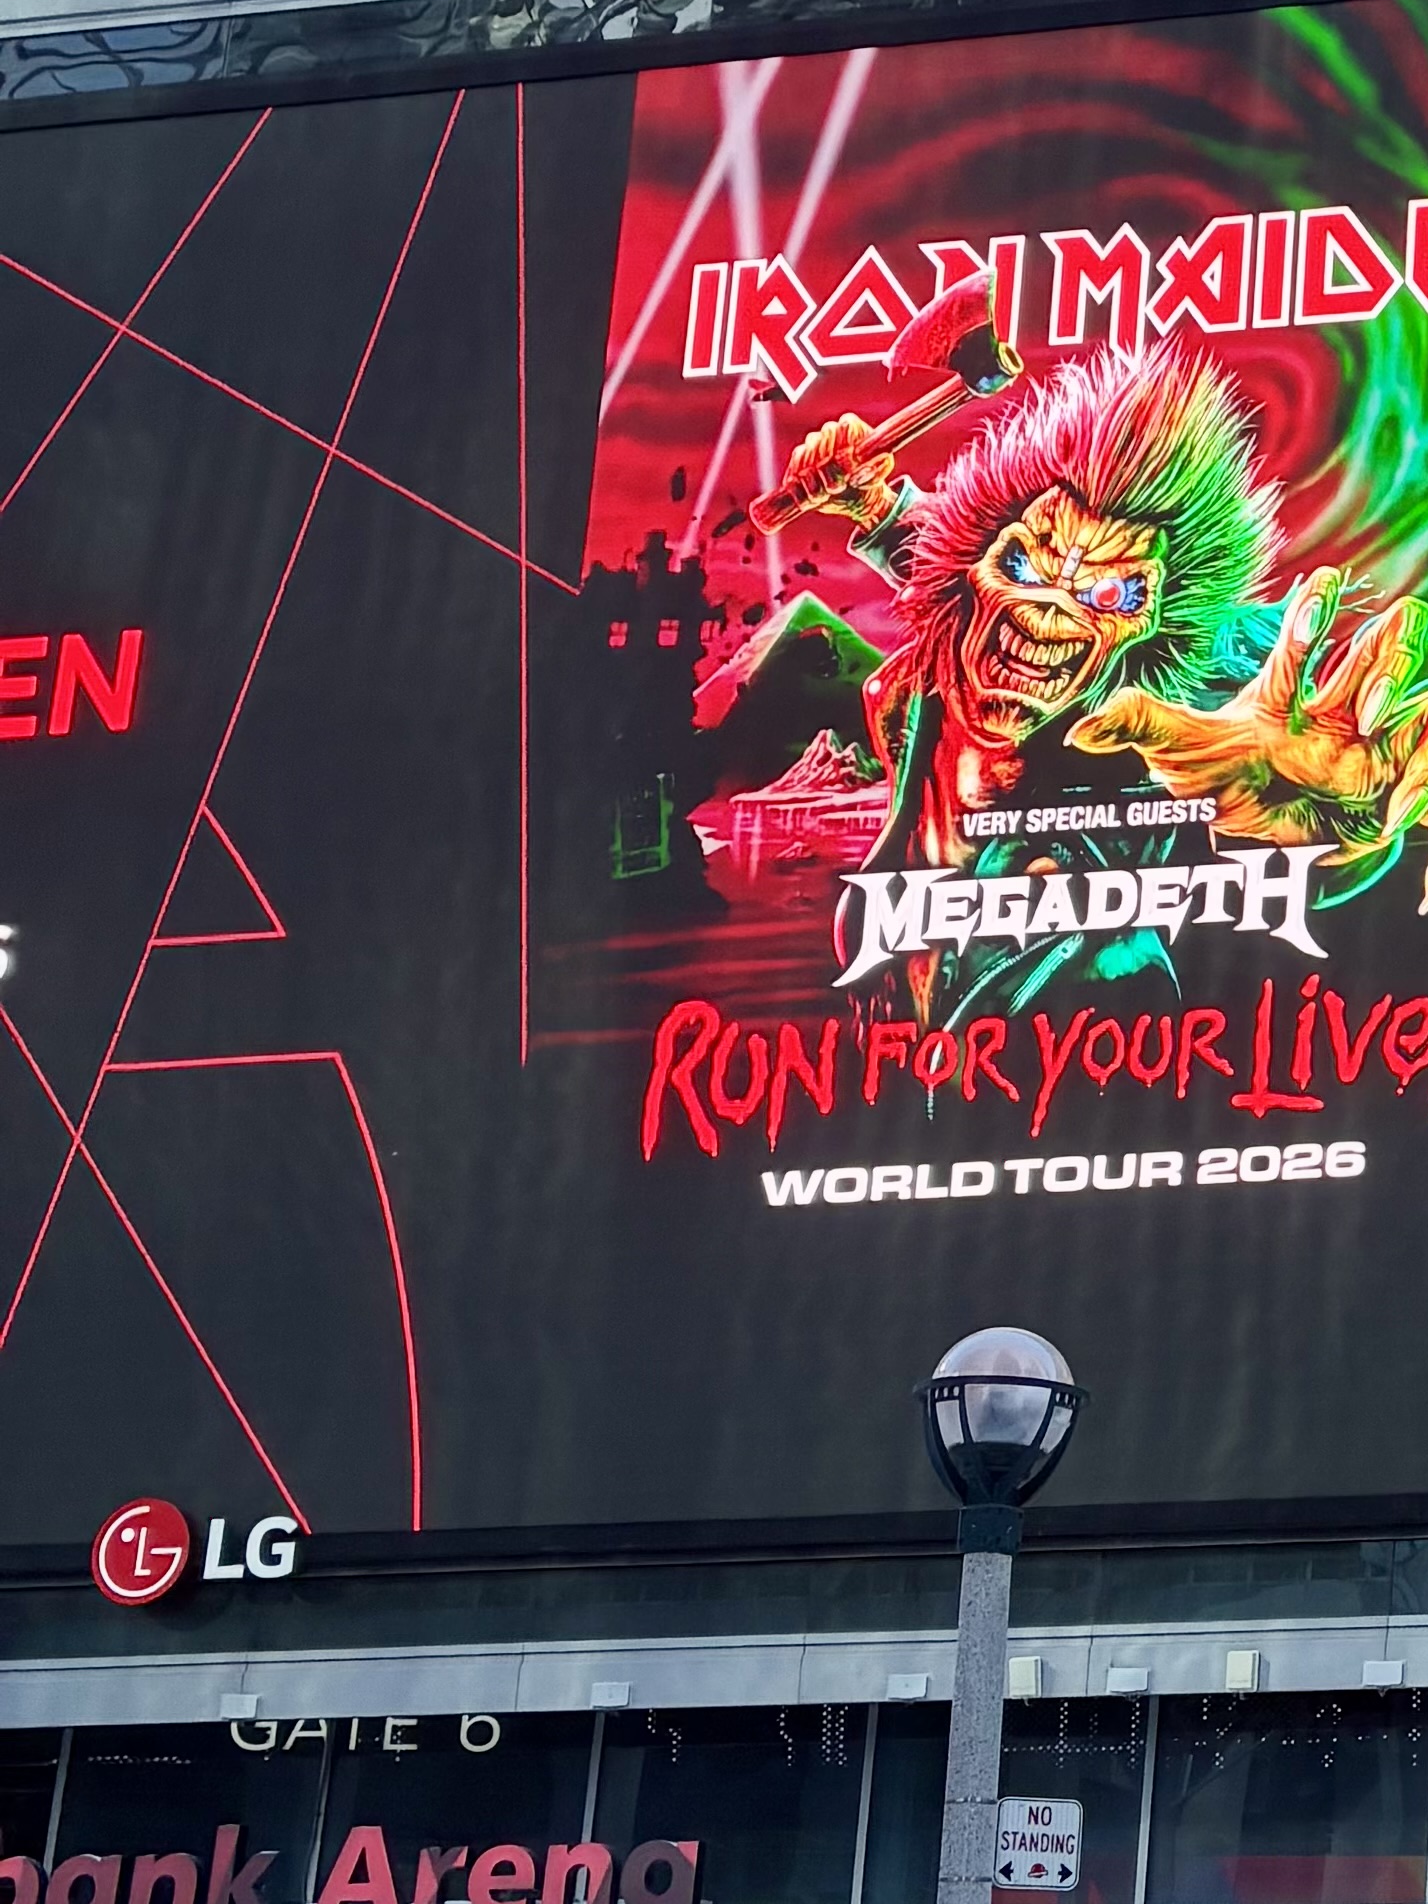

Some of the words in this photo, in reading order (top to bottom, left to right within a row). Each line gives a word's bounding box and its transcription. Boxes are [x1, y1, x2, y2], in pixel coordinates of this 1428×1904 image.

[683, 234, 1026, 403] IRON
[962, 808, 1023, 837] VERY
[1025, 801, 1122, 833] SPECIAL
[1127, 797, 1217, 825] GUESTS
[831, 843, 1339, 988] MEGADETH
[641, 998, 841, 1162] RUN
[861, 1016, 1021, 1106] FOR
[1030, 1006, 1236, 1138] YOUR
[761, 1160, 997, 1208] WORLD
[1002, 1148, 1183, 1196] TOUR
[1196, 1140, 1368, 1184] 2026
[202, 1516, 299, 1580] LG
[1000, 1830, 1076, 1854] STANDING
[1027, 1805, 1053, 1826] NO
